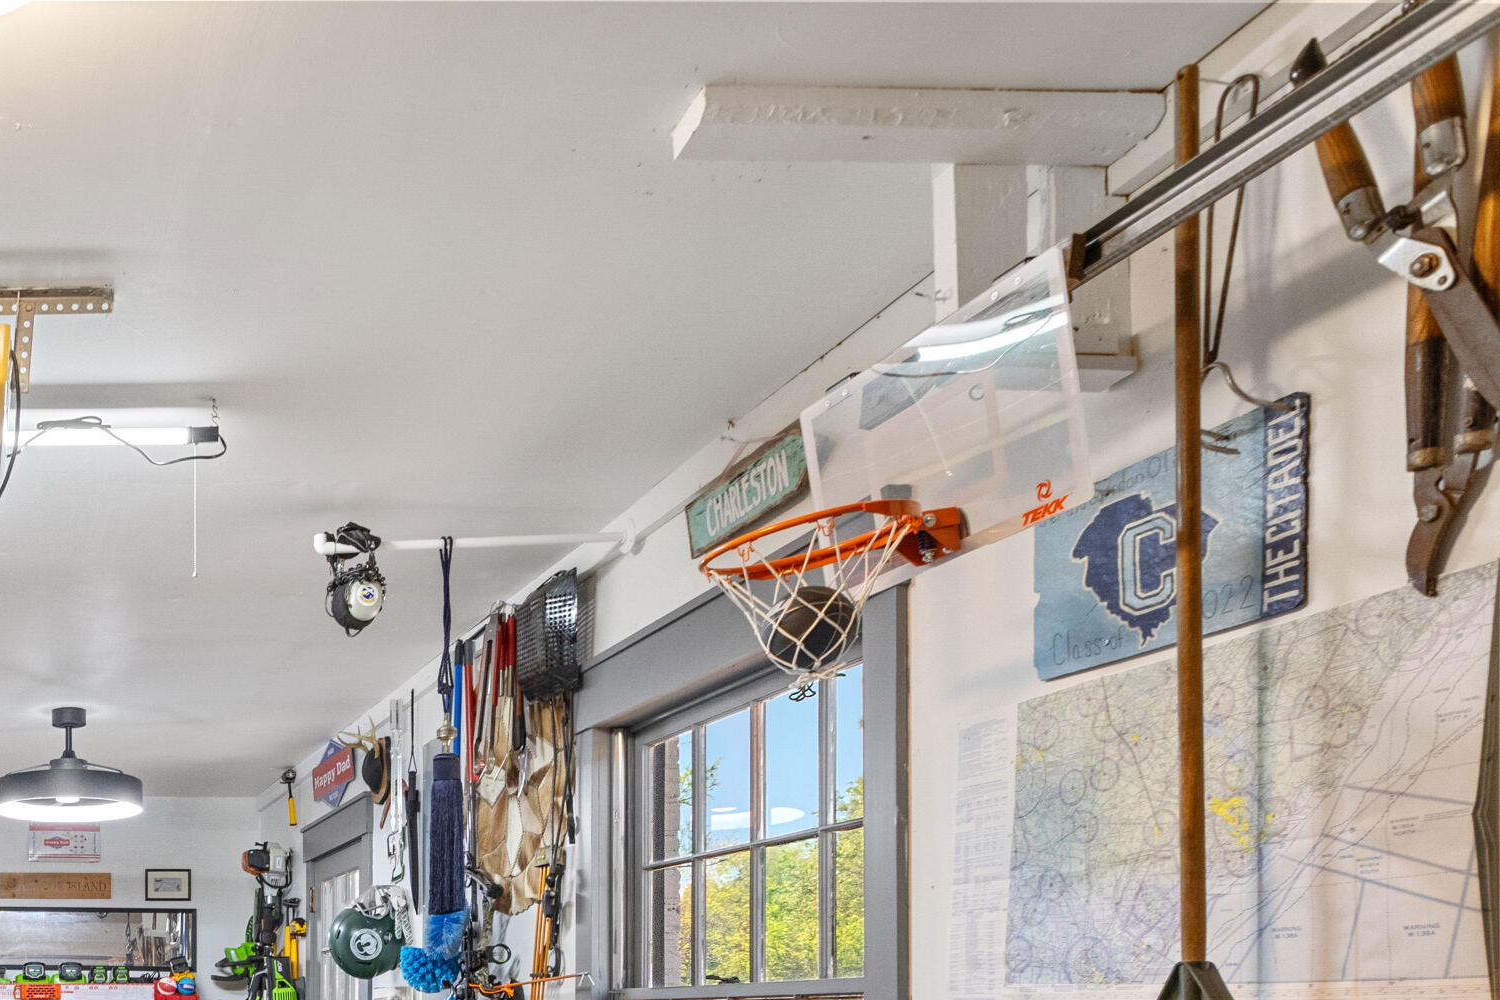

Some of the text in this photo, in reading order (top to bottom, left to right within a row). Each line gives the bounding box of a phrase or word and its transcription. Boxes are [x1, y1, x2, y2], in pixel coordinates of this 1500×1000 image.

[706, 449, 790, 537] CHARLESTON
[1021, 491, 1074, 526] TEKK
[1264, 399, 1302, 611] THE CITADEL
[1052, 631, 1106, 666] Class
[1202, 574, 1254, 619] 022
[314, 755, 351, 790] Happy Dad
[1403, 921, 1441, 932] WARNING
